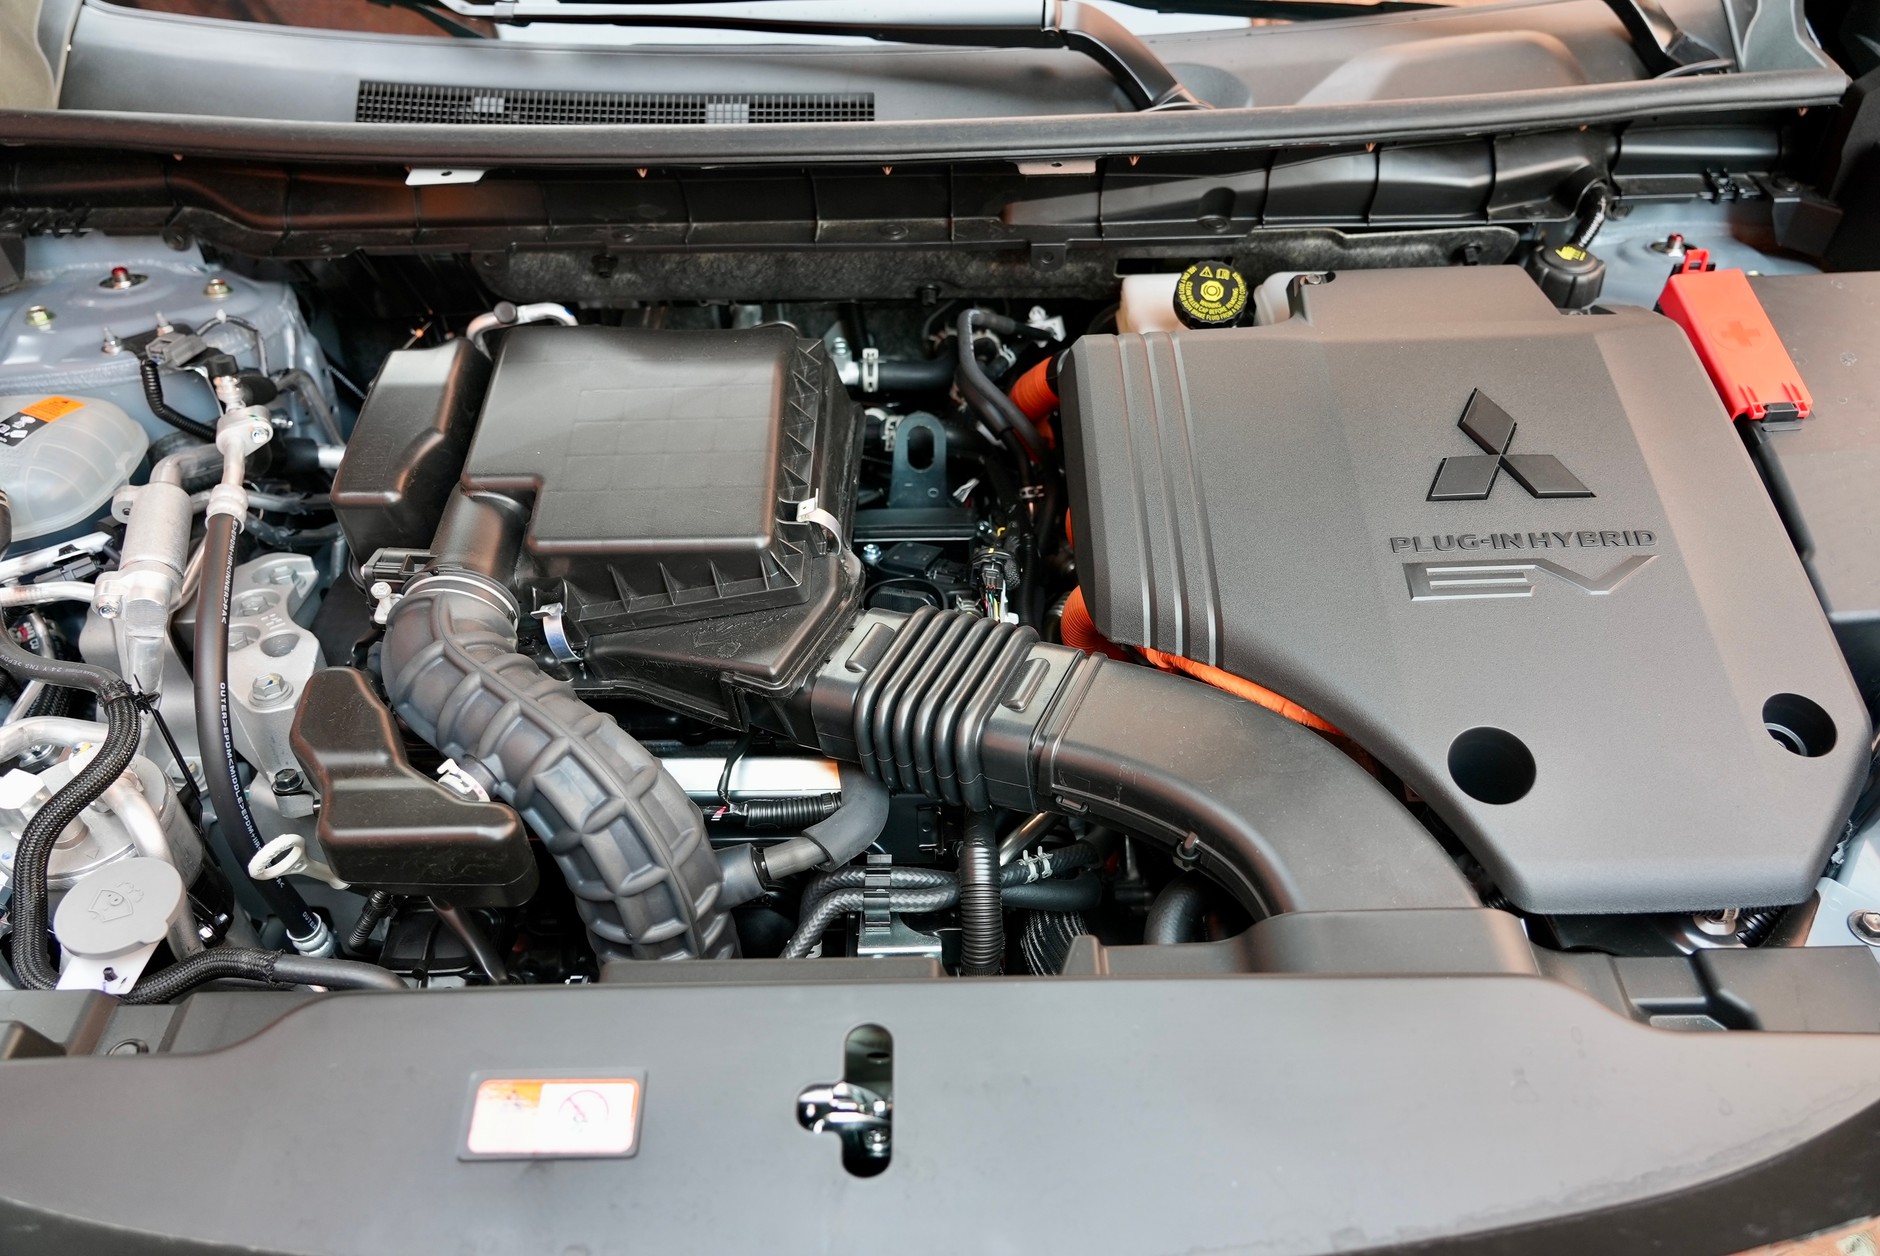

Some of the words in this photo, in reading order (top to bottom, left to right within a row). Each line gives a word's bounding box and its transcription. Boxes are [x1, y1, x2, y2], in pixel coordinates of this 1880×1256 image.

[1198, 306, 1209, 314] CAP
[1208, 305, 1228, 315] BEFORE
[1220, 310, 1234, 320] FROM
[1390, 532, 1525, 554] PLUG-IN
[1530, 530, 1658, 550] HYBRID
[1401, 555, 1661, 602] EV
